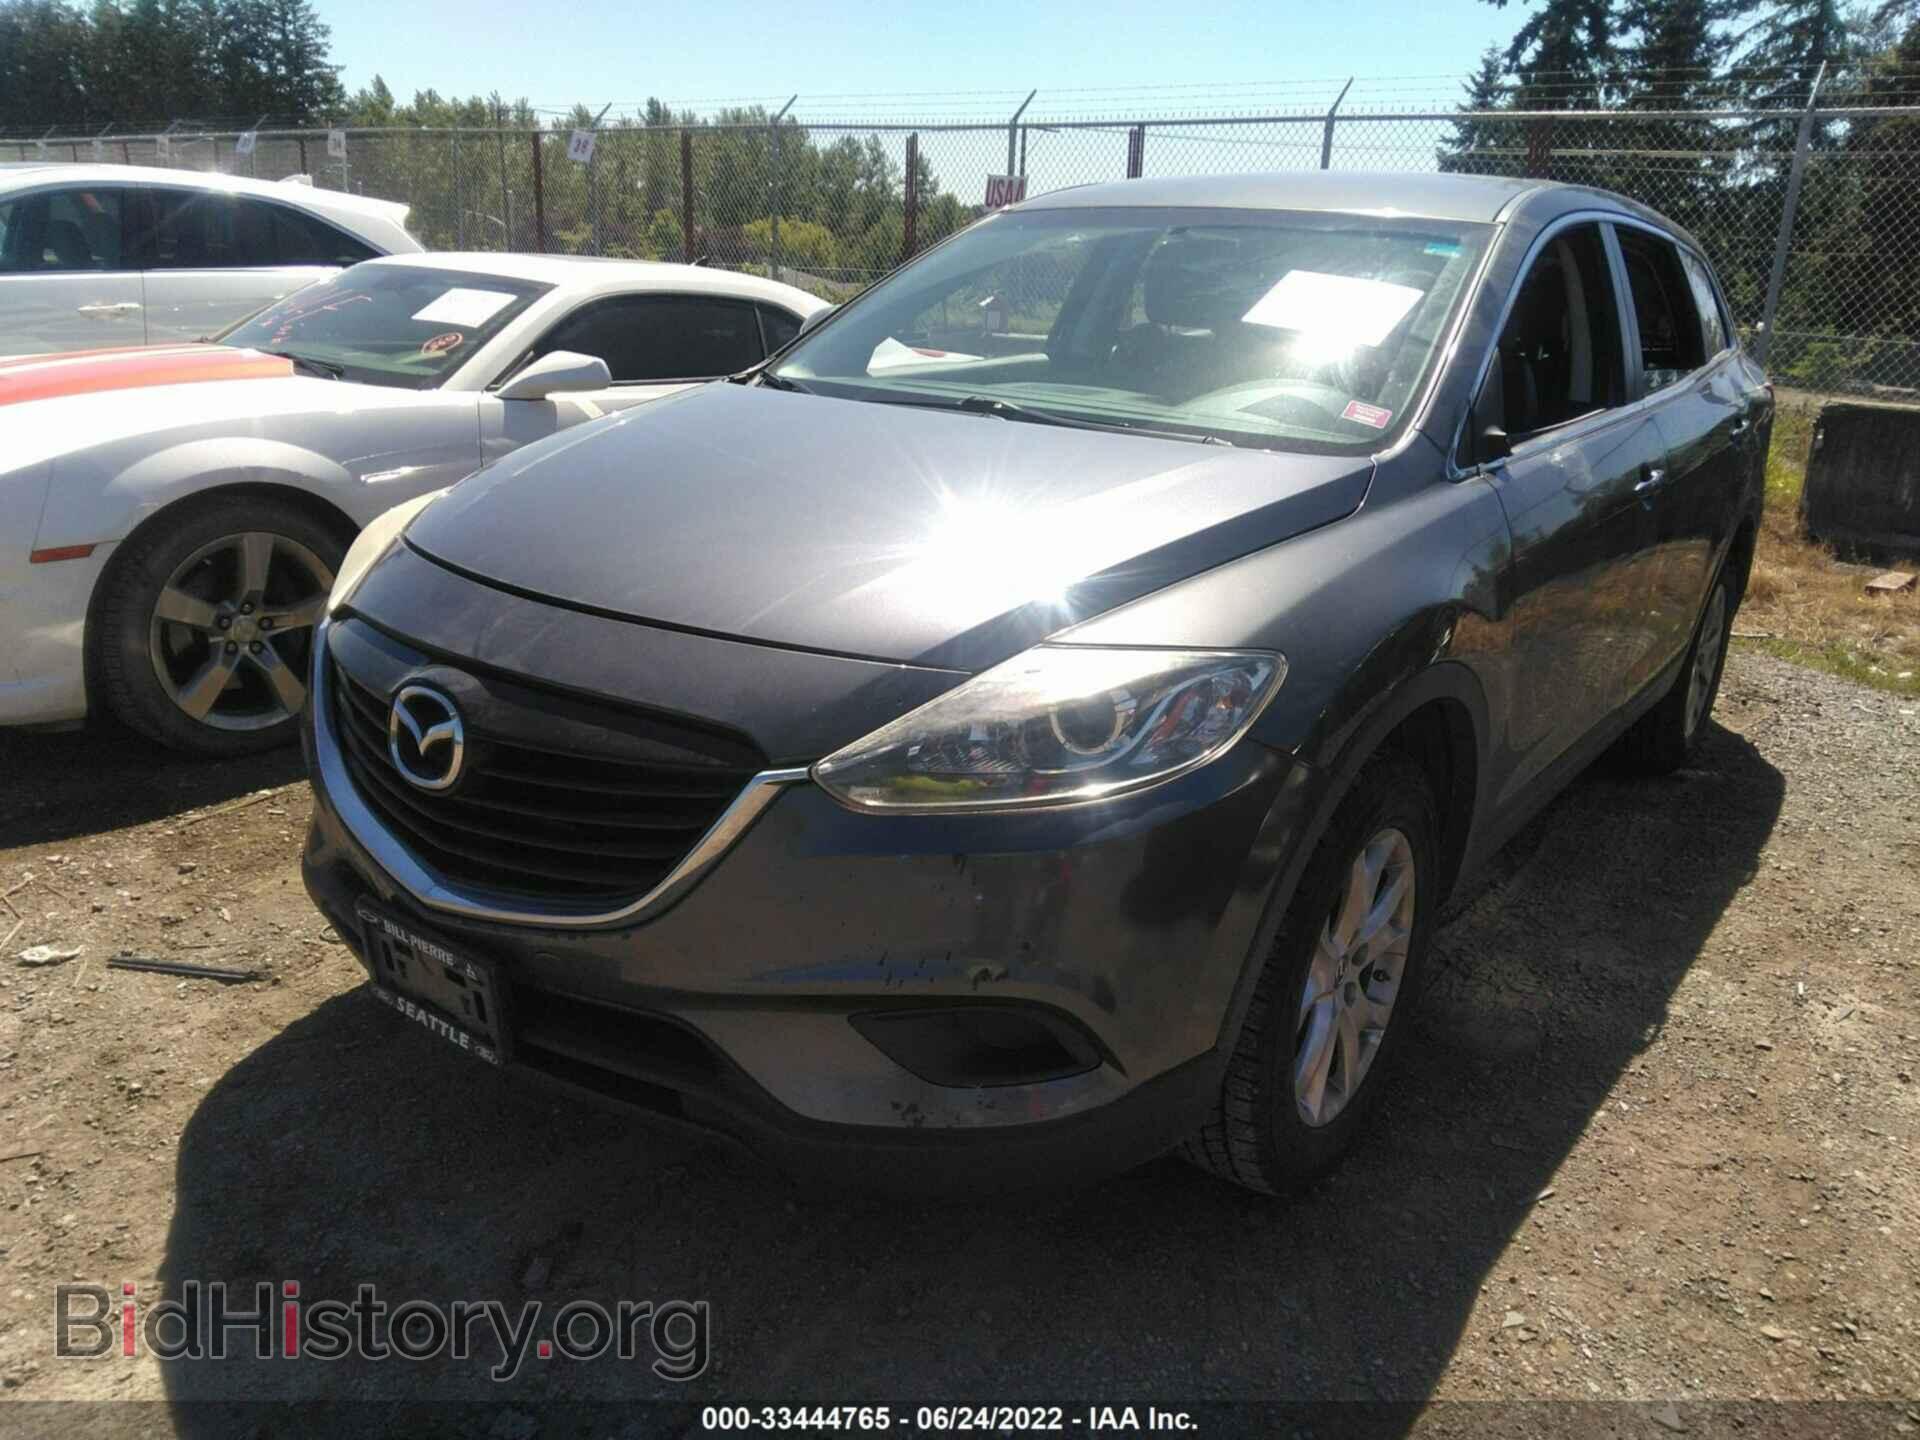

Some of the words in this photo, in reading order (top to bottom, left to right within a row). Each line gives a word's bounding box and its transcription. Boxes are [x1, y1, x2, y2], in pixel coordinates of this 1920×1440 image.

[985, 178, 1025, 207] USAA
[383, 919, 409, 943] BILL
[410, 937, 454, 967] PIERRE
[396, 997, 470, 1049] SEATTLE
